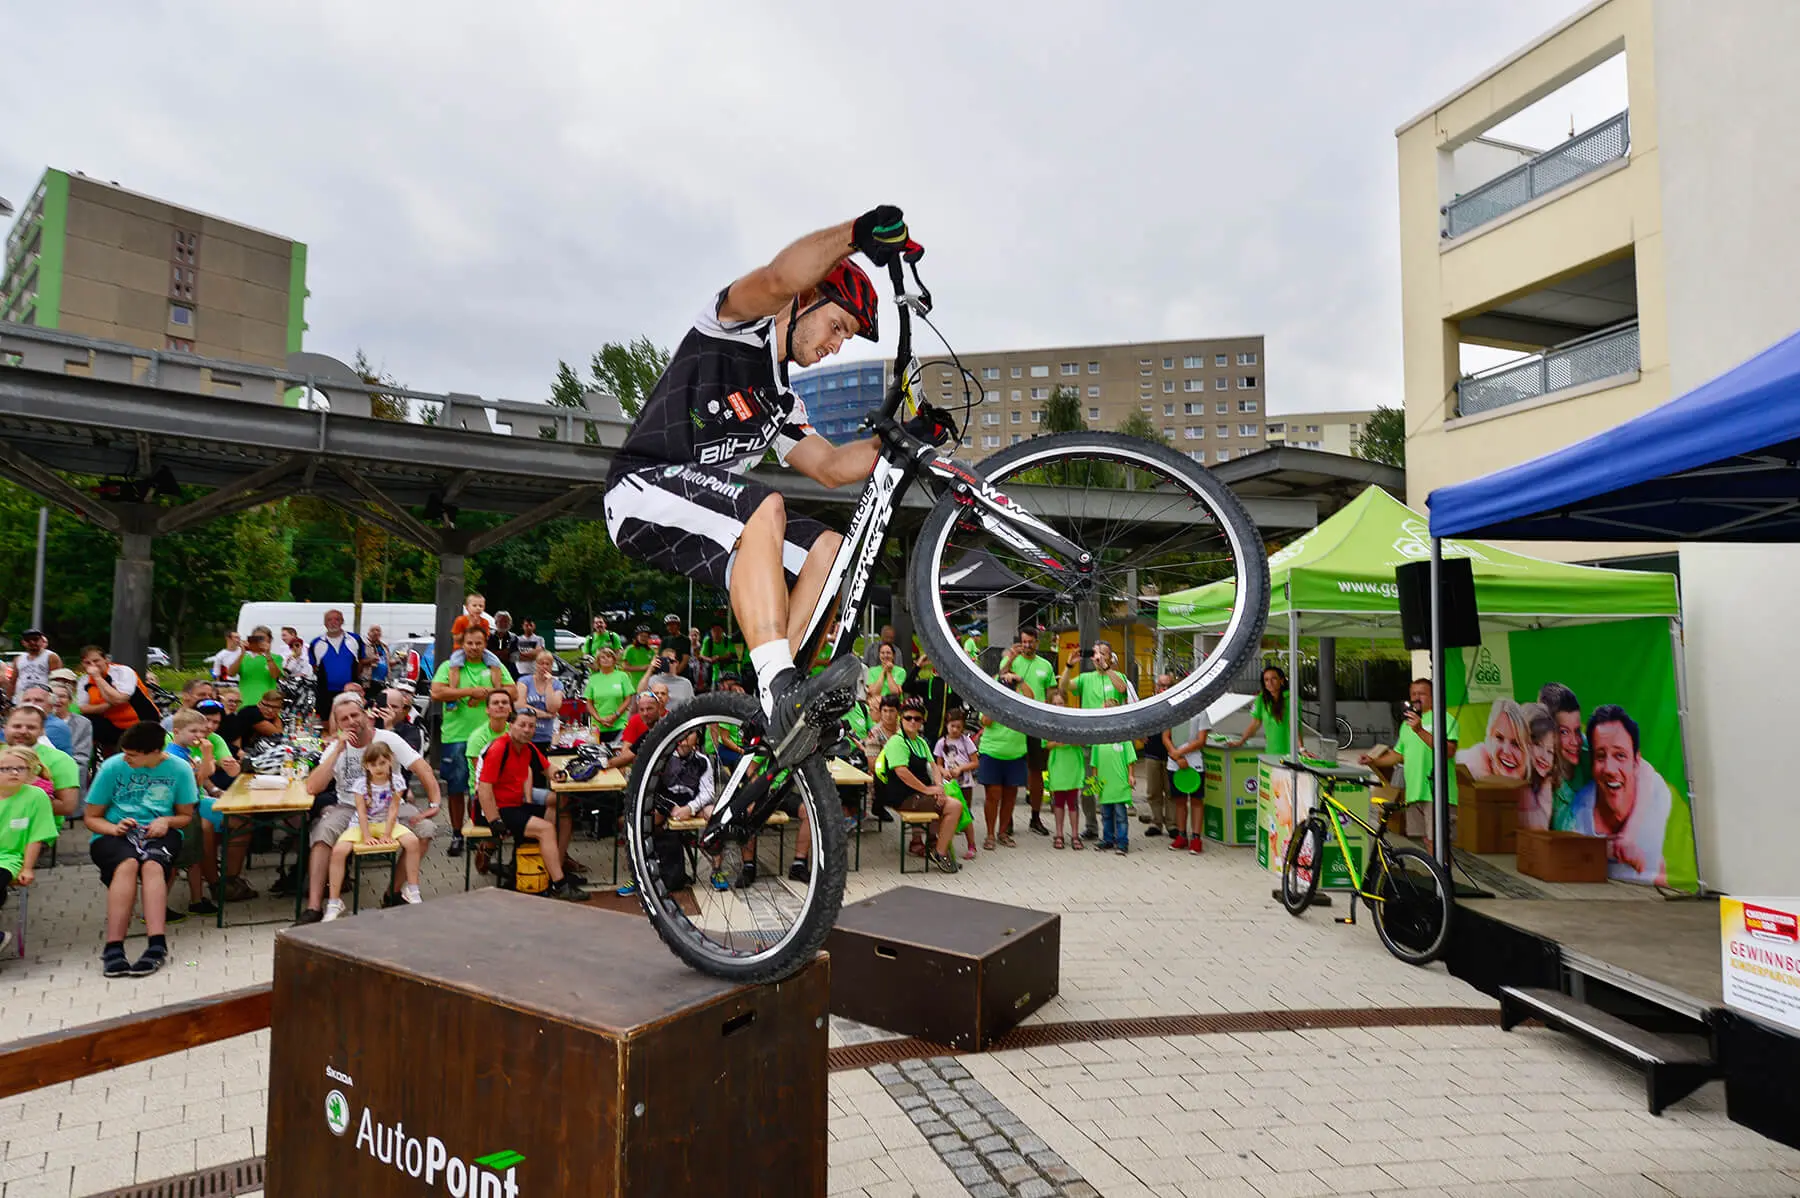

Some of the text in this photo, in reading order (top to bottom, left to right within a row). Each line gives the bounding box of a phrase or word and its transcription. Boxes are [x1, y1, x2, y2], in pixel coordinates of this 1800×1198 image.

[678, 469, 744, 500] AutoPoint
[846, 478, 876, 546] JEALOUSY
[1475, 670, 1501, 682] GGG
[355, 1106, 519, 1198] AutoPoint
